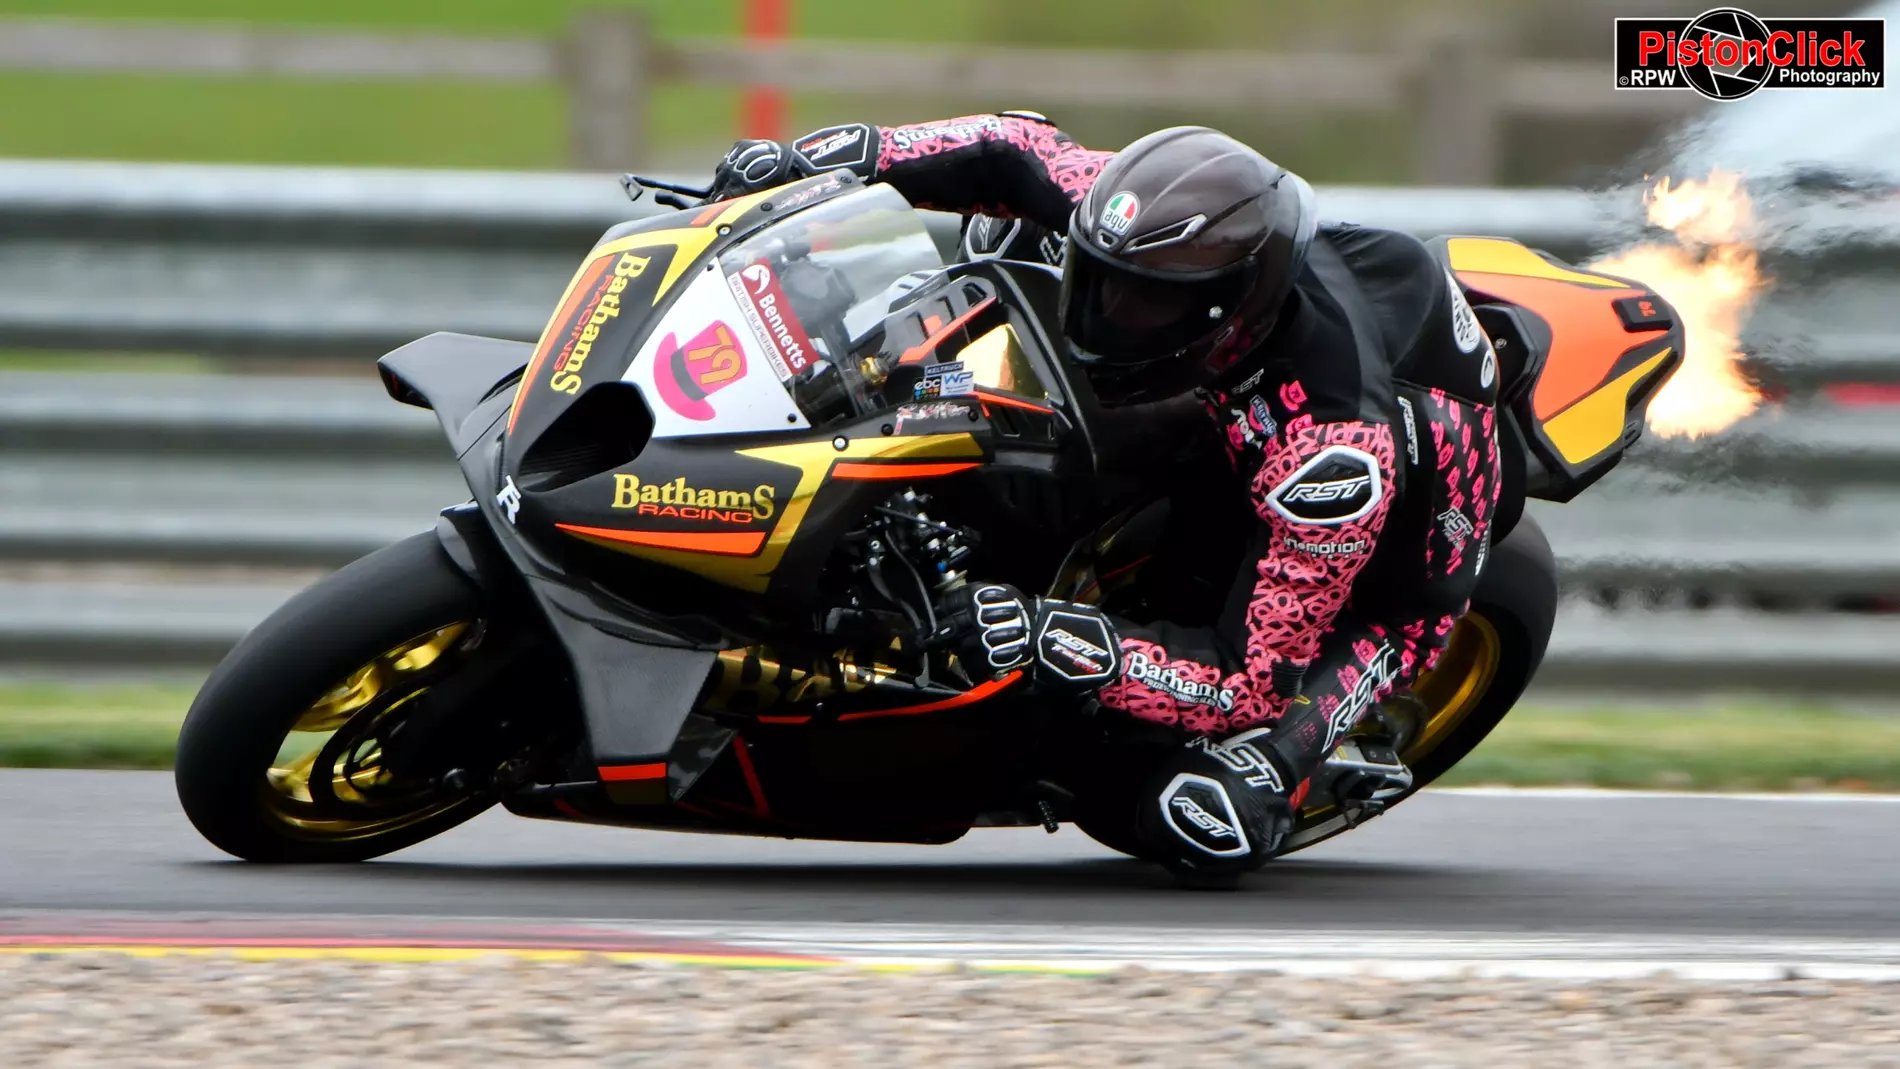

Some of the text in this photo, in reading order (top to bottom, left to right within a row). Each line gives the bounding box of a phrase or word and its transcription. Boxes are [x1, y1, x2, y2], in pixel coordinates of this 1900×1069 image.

[553, 274, 615, 371] RACING
[730, 276, 789, 378] BRITISH SUPERBIKES
[758, 293, 807, 369] Bennetts
[687, 324, 742, 385] 79
[913, 375, 941, 390] ebc
[1283, 475, 1370, 502] RST
[638, 503, 753, 523] RACING
[1437, 506, 1474, 541] RST
[1044, 628, 1109, 658] RST
[1321, 638, 1396, 754] RST
[1171, 796, 1238, 839] RST
